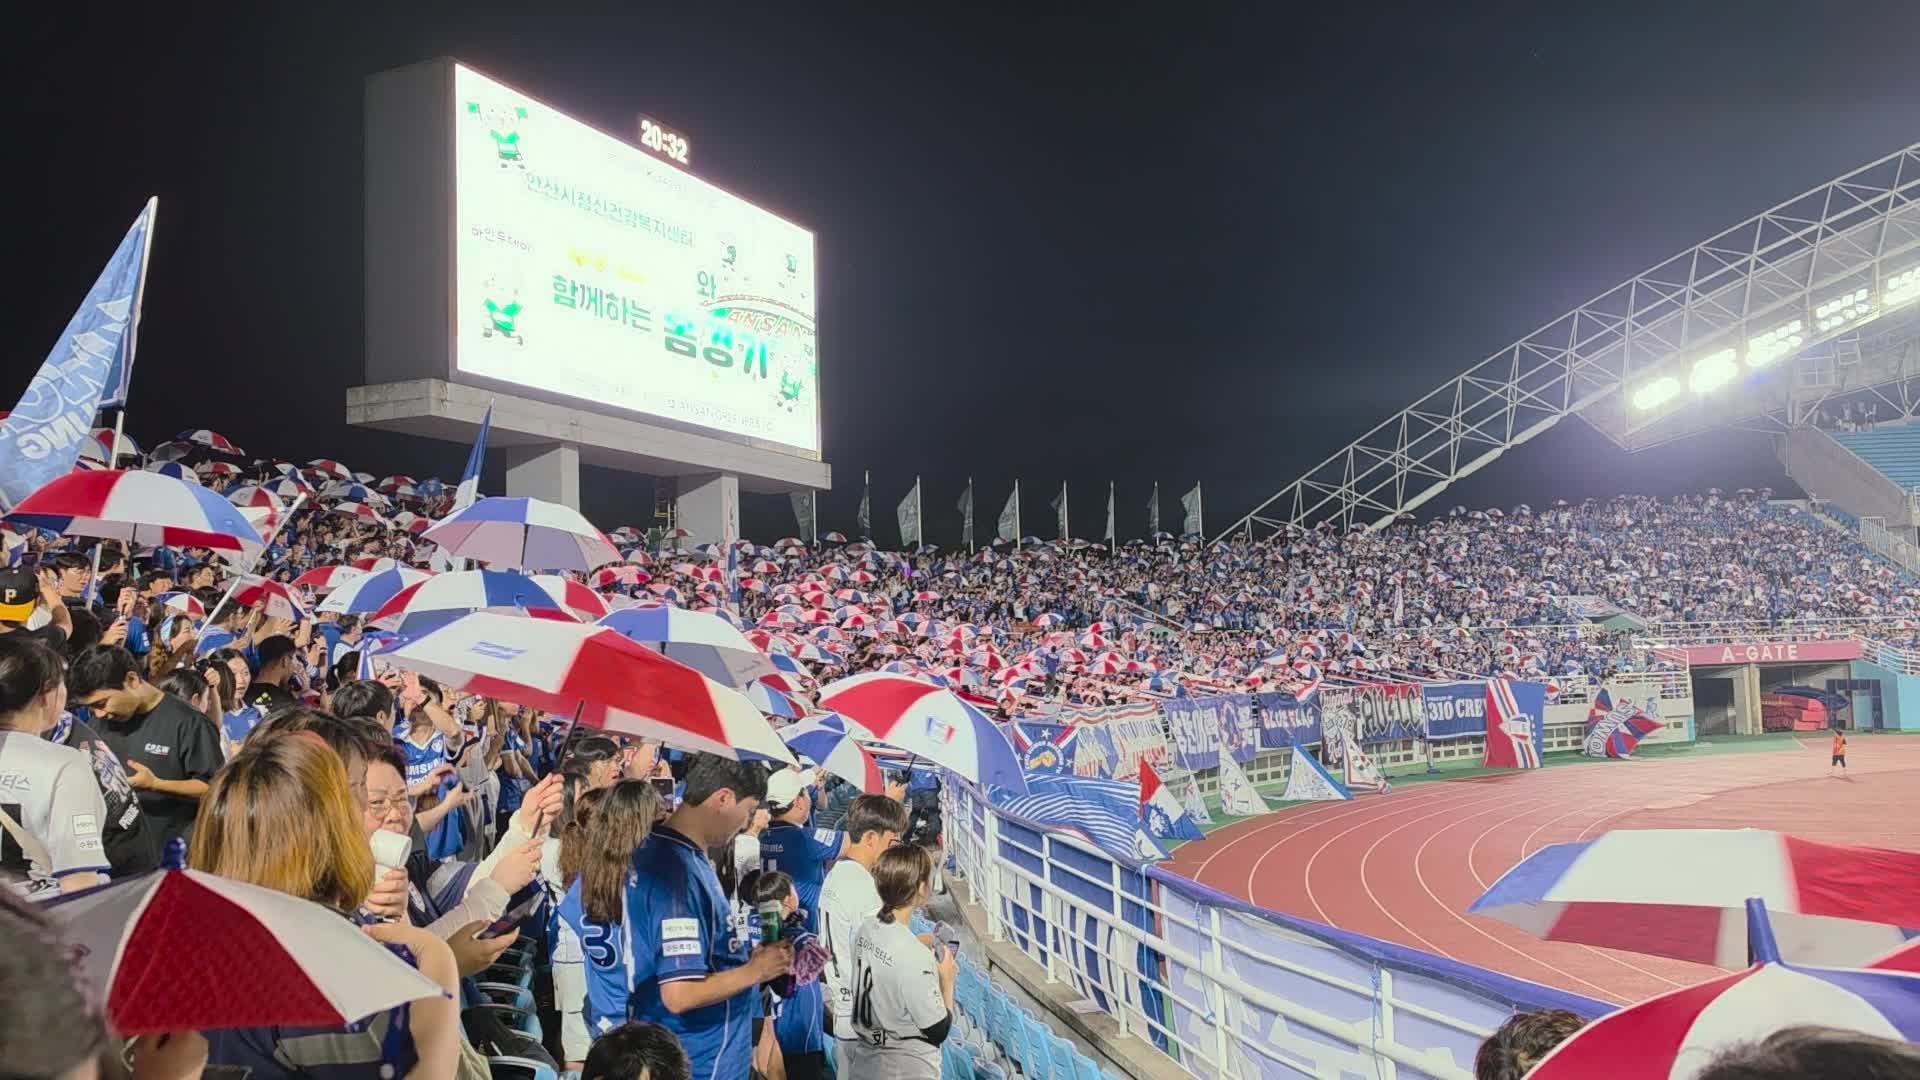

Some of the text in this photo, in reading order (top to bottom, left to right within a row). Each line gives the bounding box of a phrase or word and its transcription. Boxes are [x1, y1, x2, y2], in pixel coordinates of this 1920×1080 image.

[641, 119, 688, 164] 20:32
[697, 271, 716, 298] 와
[552, 275, 652, 332] 함께하는
[5, 588, 17, 603] P
[1721, 645, 1798, 663] A-GATE
[1427, 701, 1454, 721] 310
